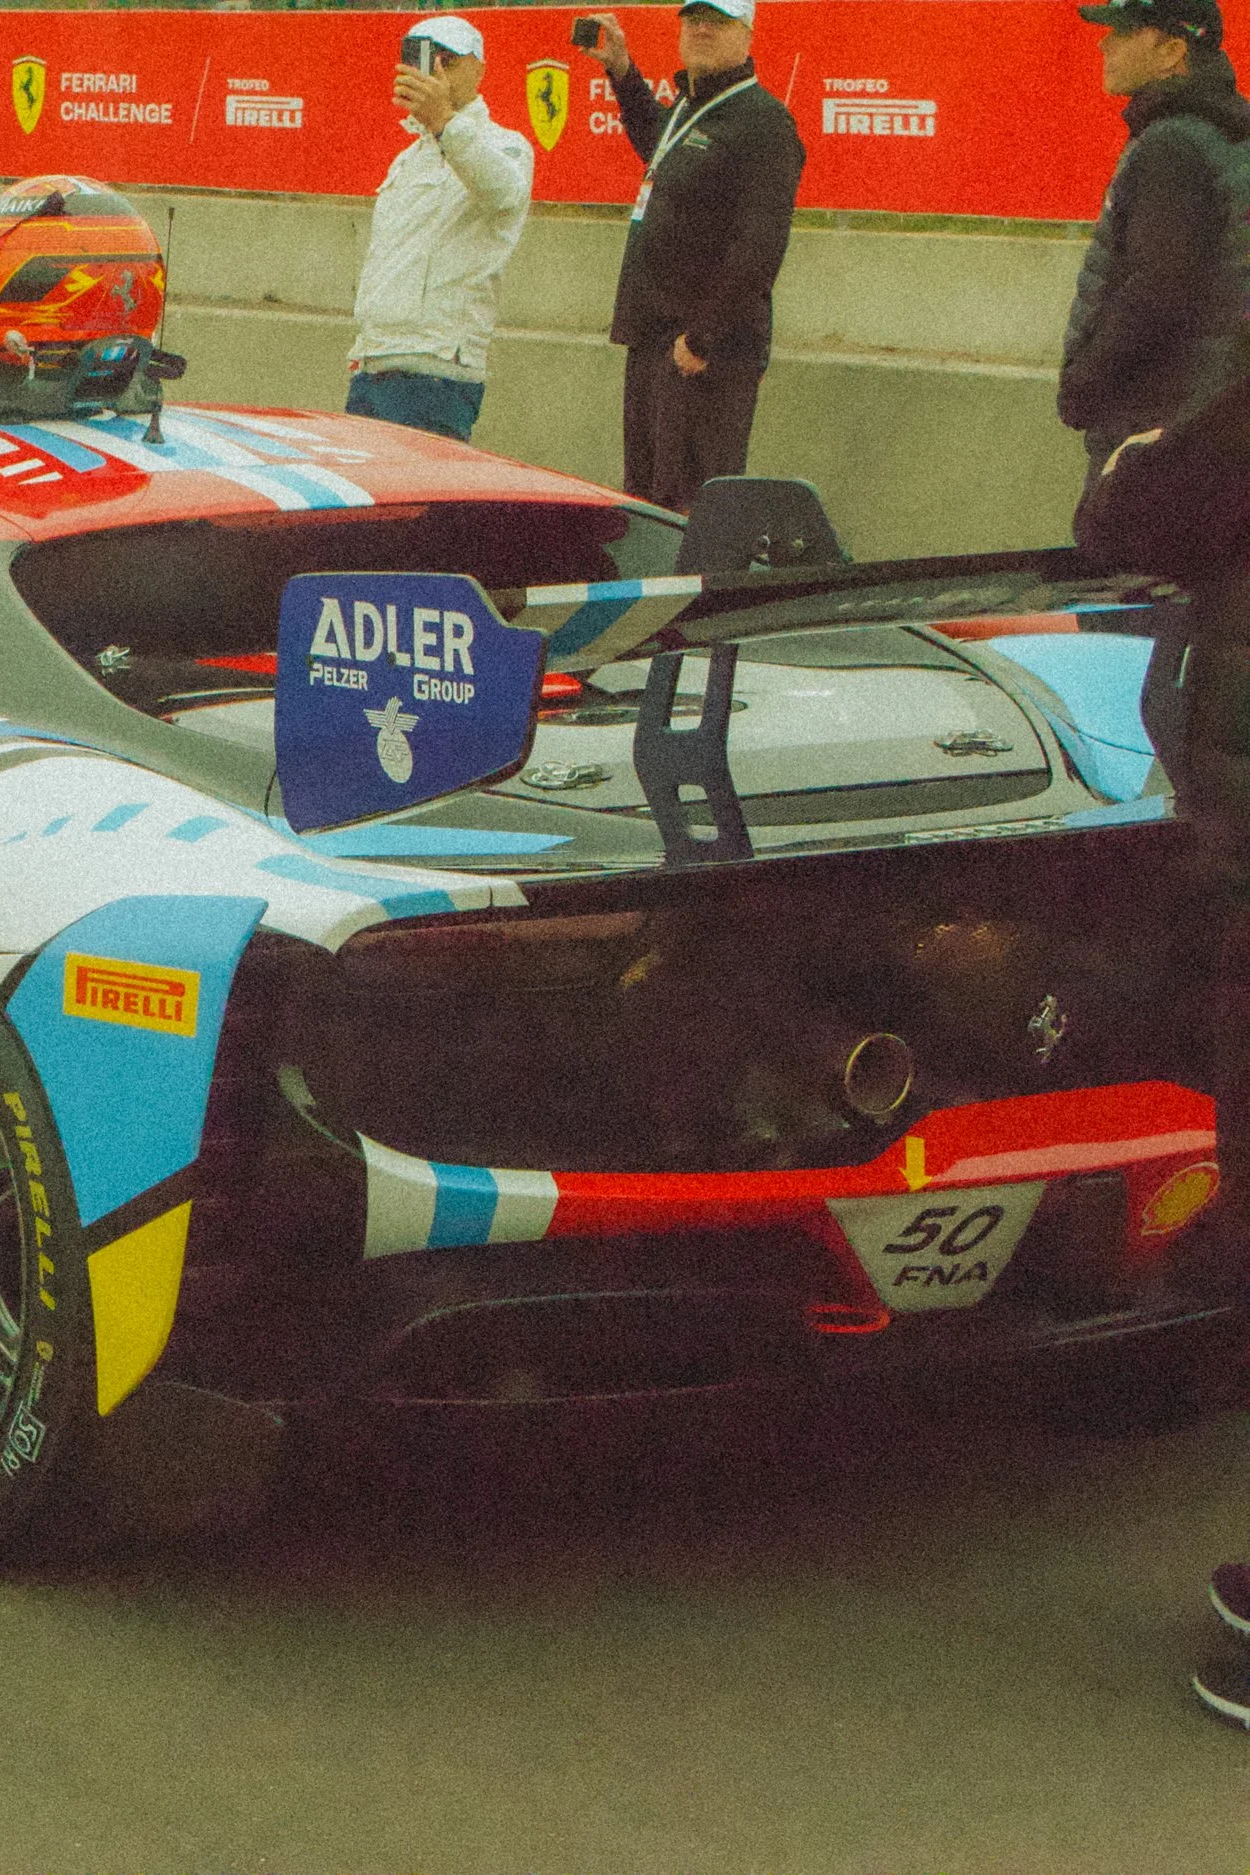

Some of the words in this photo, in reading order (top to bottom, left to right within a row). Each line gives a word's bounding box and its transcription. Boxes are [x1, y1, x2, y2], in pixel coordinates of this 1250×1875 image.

[60, 73, 137, 93] FERRARI
[227, 79, 269, 91] TROFEO
[823, 78, 889, 93] TROFEO
[60, 102, 173, 124] CHALLENGE
[225, 95, 303, 128] PIRELLI
[822, 98, 937, 136] PIRELLI
[310, 597, 475, 675] ADLER
[309, 663, 368, 691] PELZER
[413, 673, 475, 704] GROUP
[76, 966, 186, 1022] PIRELLI
[2, 1091, 56, 1311] PIRELLI
[882, 1204, 1005, 1256] 50
[892, 1261, 990, 1289] FNA
